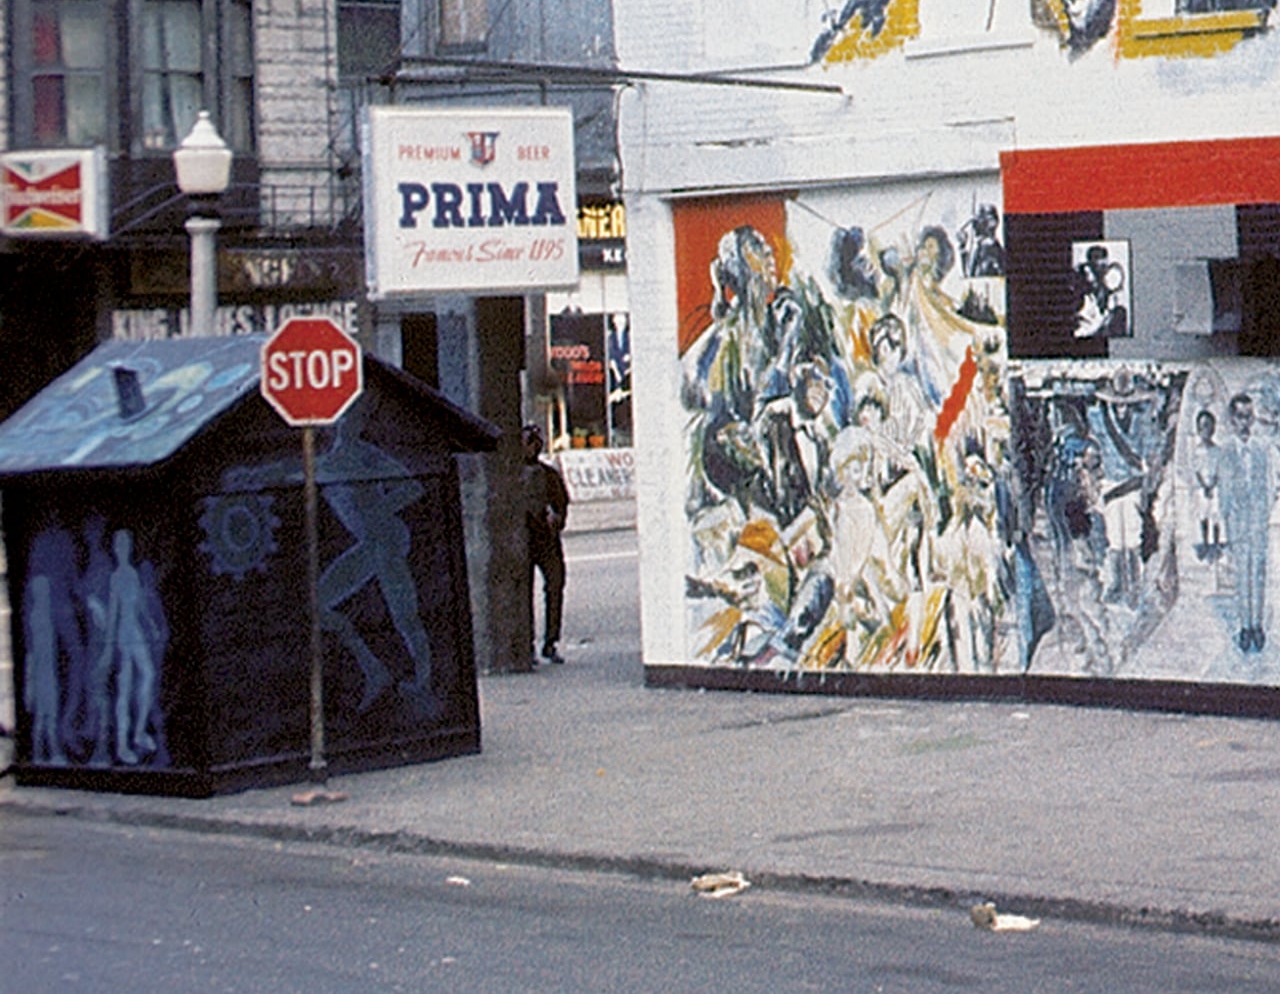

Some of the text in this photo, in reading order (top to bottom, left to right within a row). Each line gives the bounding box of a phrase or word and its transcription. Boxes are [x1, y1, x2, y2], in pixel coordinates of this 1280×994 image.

[399, 144, 550, 162] PREMIUM BEER
[398, 182, 567, 228] PRIMA
[403, 240, 473, 268] Famous
[475, 239, 524, 262] Since
[111, 308, 169, 341] KING
[269, 350, 353, 390] STOP
